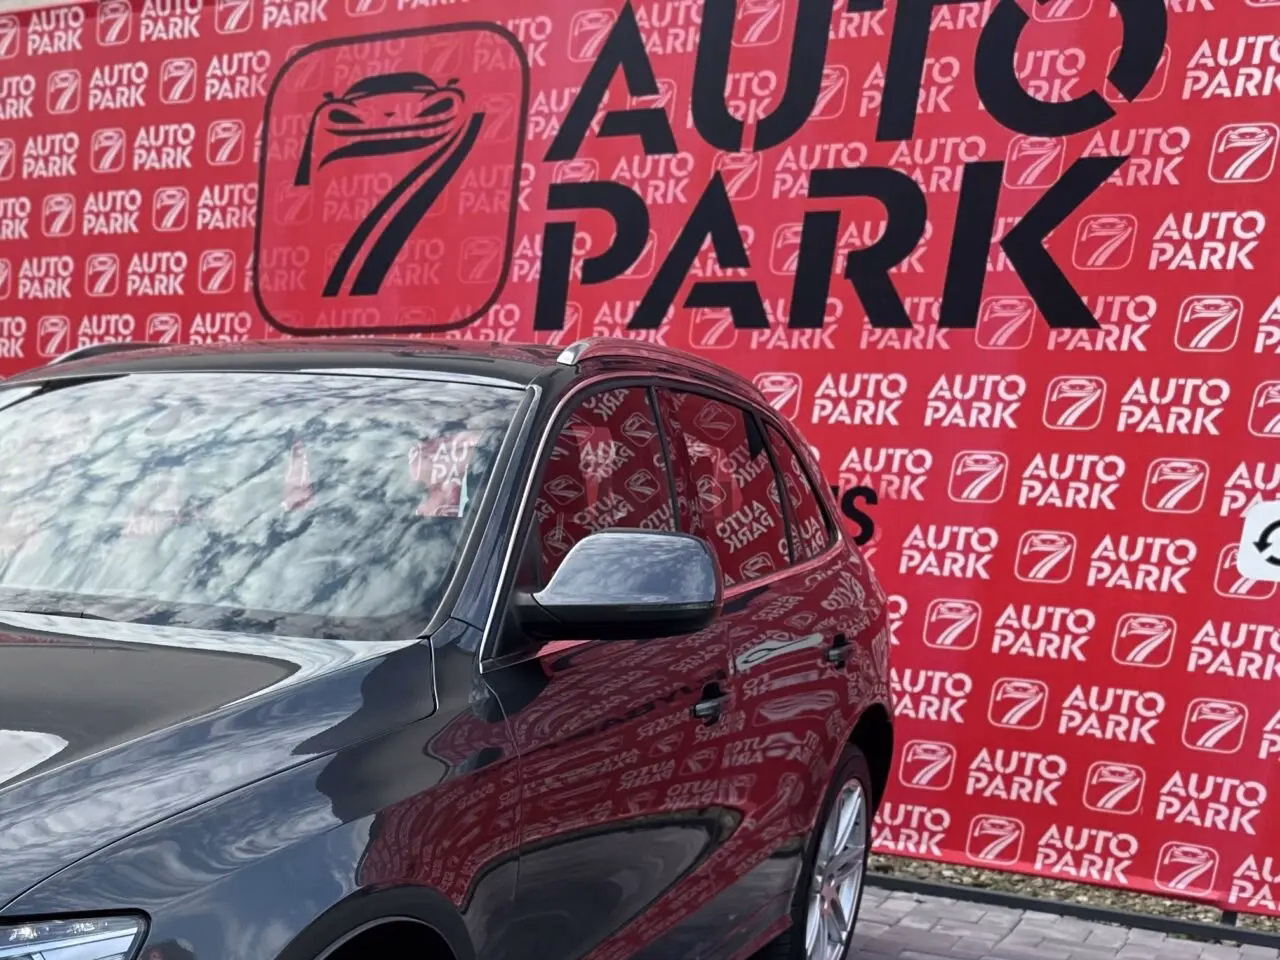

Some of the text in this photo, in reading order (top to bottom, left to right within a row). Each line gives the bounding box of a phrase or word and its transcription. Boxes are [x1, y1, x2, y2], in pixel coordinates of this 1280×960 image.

[28, 6, 85, 32] AUTO
[140, 16, 200, 42] PARK
[262, 1, 327, 30] PARK
[28, 28, 83, 55] PARK
[90, 62, 148, 88] AUTO
[206, 50, 270, 76] AUTO
[205, 74, 268, 100] PARK
[544, 0, 1168, 162] AUTO
[88, 85, 147, 110] PARK
[24, 132, 79, 156] AUTO
[134, 123, 195, 148] AUTO
[1080, 126, 1191, 158] AUTO
[132, 147, 192, 171] PARK
[776, 142, 868, 171] AUTO
[888, 136, 986, 166] AUTO
[22, 153, 77, 179] PARK
[611, 152, 694, 180] AUTO
[84, 189, 141, 213] AUTO
[197, 183, 258, 207] AUTO
[82, 212, 139, 235] PARK
[196, 206, 256, 230] PARK
[1153, 211, 1266, 241] AUTO
[534, 156, 1131, 330] PARK
[1149, 241, 1260, 270] PARK
[19, 256, 74, 278] AUTO
[128, 251, 187, 273] AUTO
[18, 276, 71, 299] PARK
[126, 272, 185, 295] PARK
[78, 314, 135, 335] AUTO
[190, 312, 251, 334] AUTO
[751, 324, 838, 350] PARK
[860, 324, 950, 350] PARK
[1048, 324, 1151, 351] PARK
[814, 372, 907, 399] AUTO
[927, 374, 1026, 401] AUTO
[1121, 377, 1231, 406] AUTO
[811, 399, 902, 425] PARK
[924, 401, 1020, 428] PARK
[1117, 405, 1224, 435] PARK
[840, 447, 933, 475] AUTO
[1022, 453, 1126, 482] AUTO
[1018, 480, 1120, 510] PARK
[903, 524, 999, 553] AUTO
[1091, 534, 1197, 566] AUTO
[899, 550, 994, 580] PARK
[1087, 561, 1191, 594] PARK
[995, 603, 1096, 635] AUTO
[992, 628, 1091, 662] PARK
[1062, 684, 1165, 718] AUTO
[1058, 709, 1159, 745] PARK
[968, 747, 1068, 780] AUTO
[965, 771, 1062, 806] PARK
[1159, 770, 1267, 808] AUTO
[1155, 795, 1261, 835] PARK
[1037, 823, 1139, 858] AUTO
[1034, 847, 1133, 885] PARK
